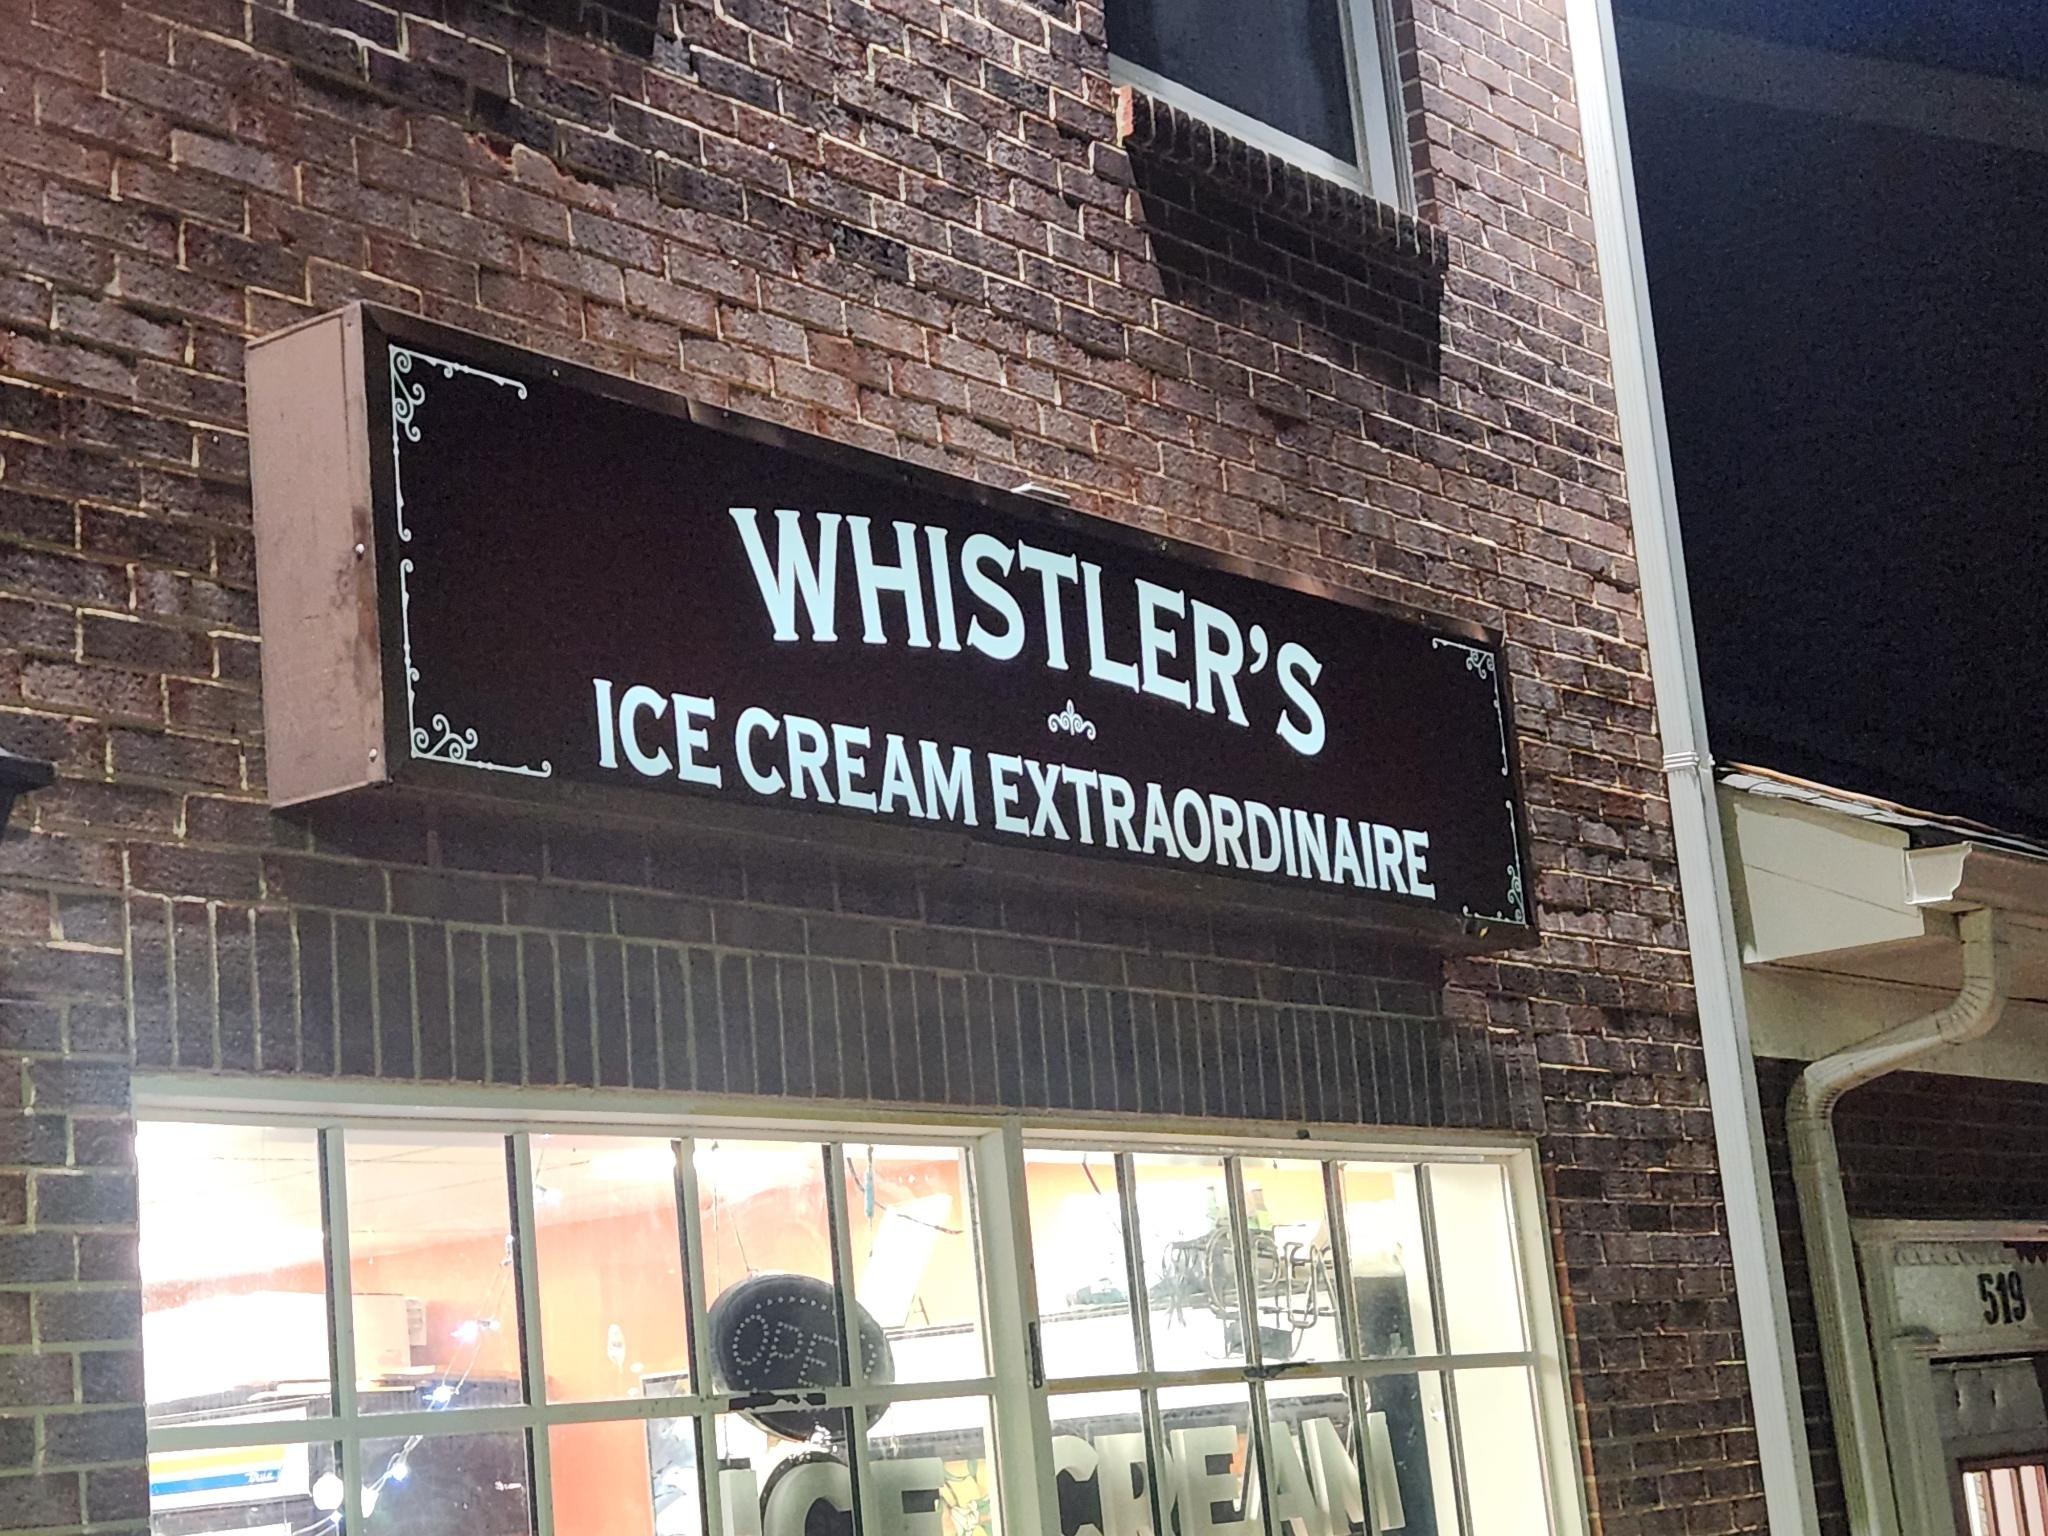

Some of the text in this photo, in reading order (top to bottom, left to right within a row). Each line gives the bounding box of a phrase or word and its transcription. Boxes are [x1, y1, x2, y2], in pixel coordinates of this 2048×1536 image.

[728, 507, 1327, 757] WHISTLER'S
[592, 677, 1437, 901] ICE CREAM EXTRAORDINAIRE
[1977, 1270, 2027, 1325] 519
